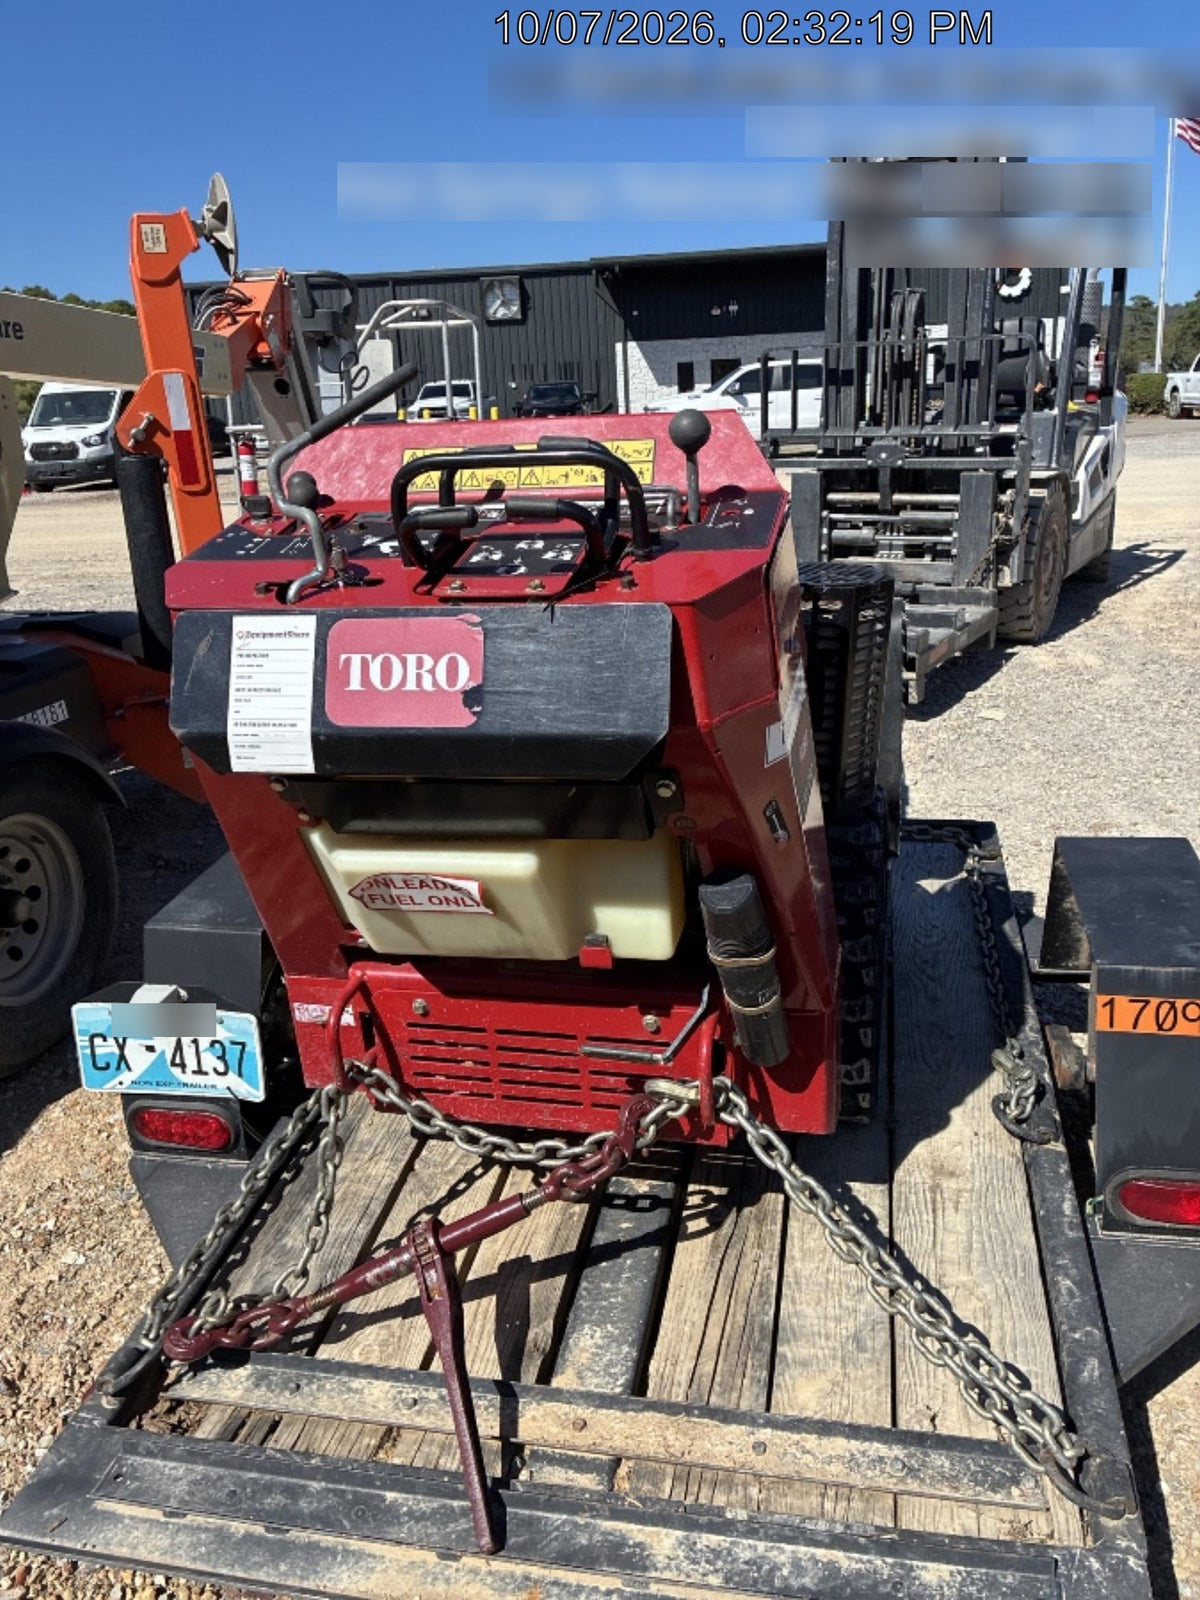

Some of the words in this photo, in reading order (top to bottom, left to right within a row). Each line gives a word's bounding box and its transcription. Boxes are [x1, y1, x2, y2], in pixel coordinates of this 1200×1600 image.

[0, 320, 24, 340] re
[339, 652, 470, 692] TORO
[368, 893, 422, 906] FUEL
